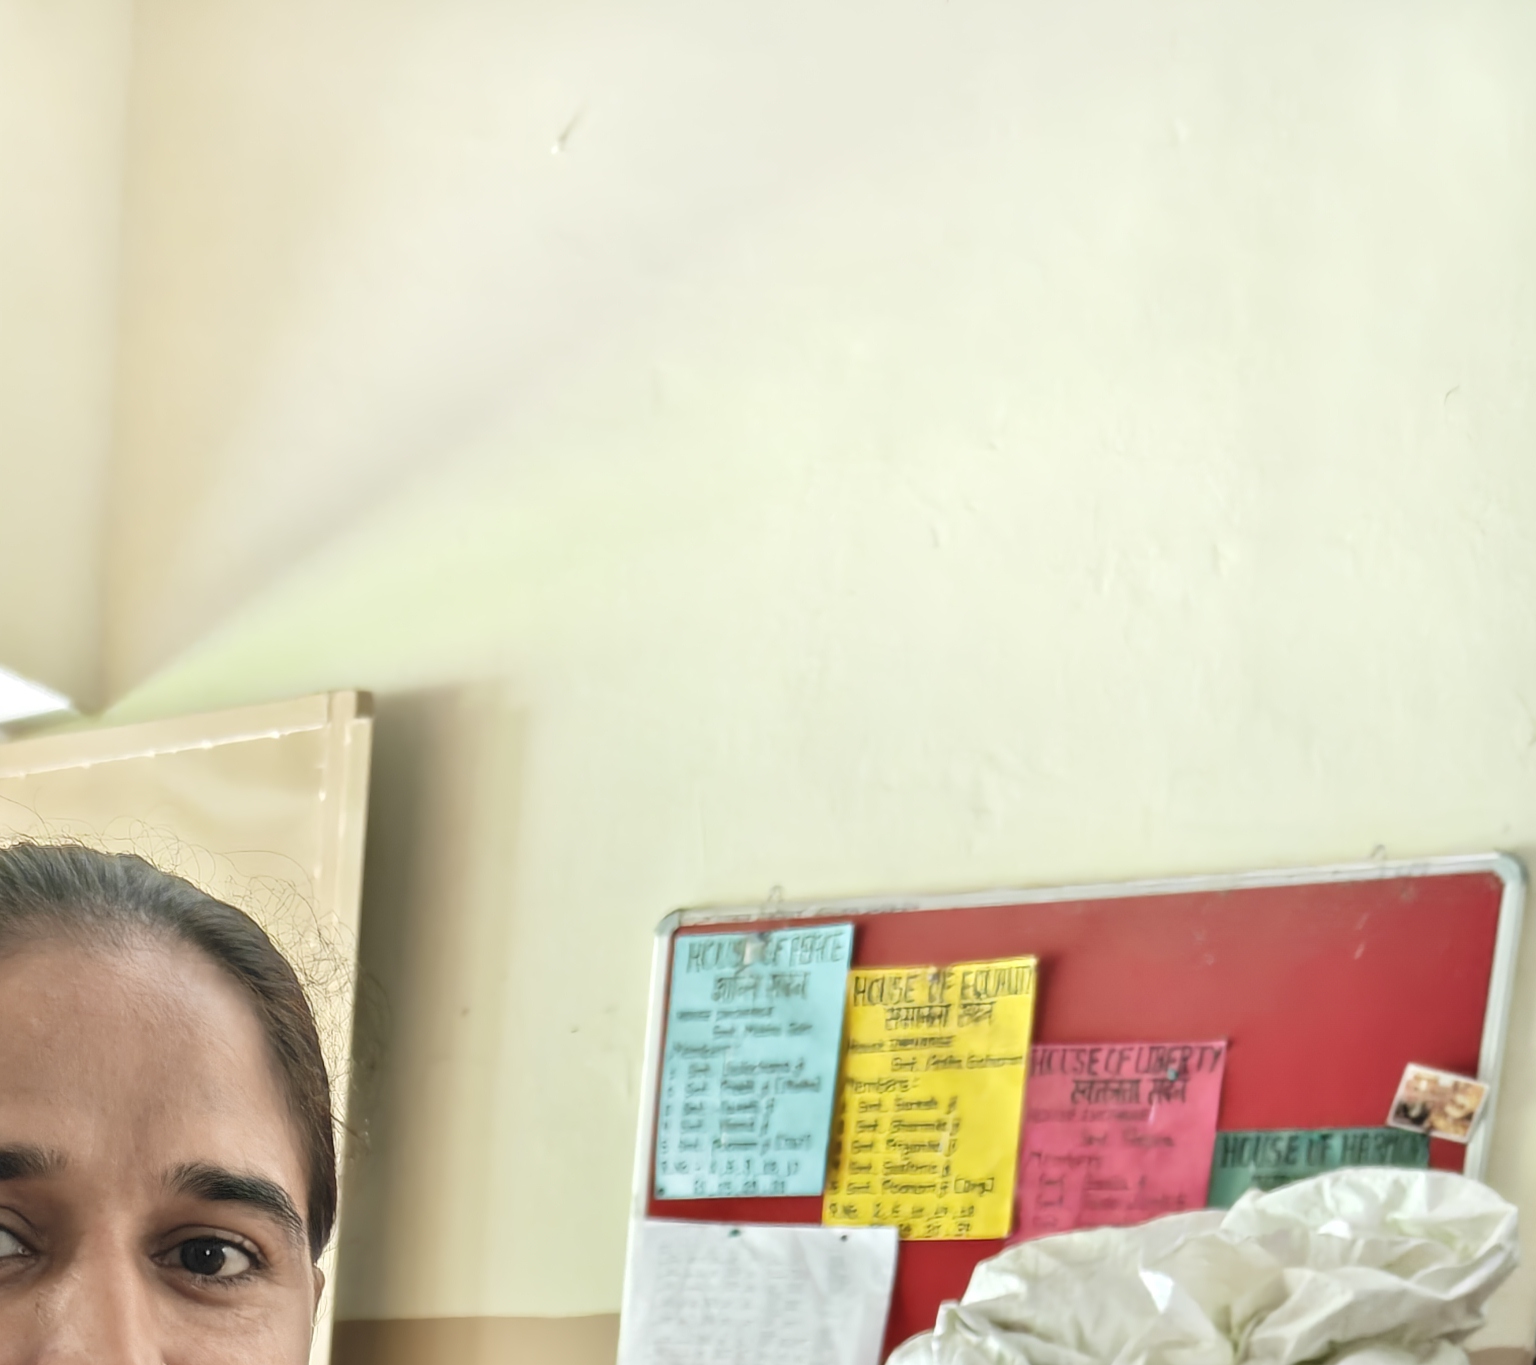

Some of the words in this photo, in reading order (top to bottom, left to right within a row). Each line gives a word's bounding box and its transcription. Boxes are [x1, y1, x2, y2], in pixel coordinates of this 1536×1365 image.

[853, 974, 920, 1007] HOUSE
[1030, 1047, 1102, 1077] HOUSE
[1135, 1045, 1225, 1076] LIBERTY
[1219, 1134, 1300, 1169] HOUSE
